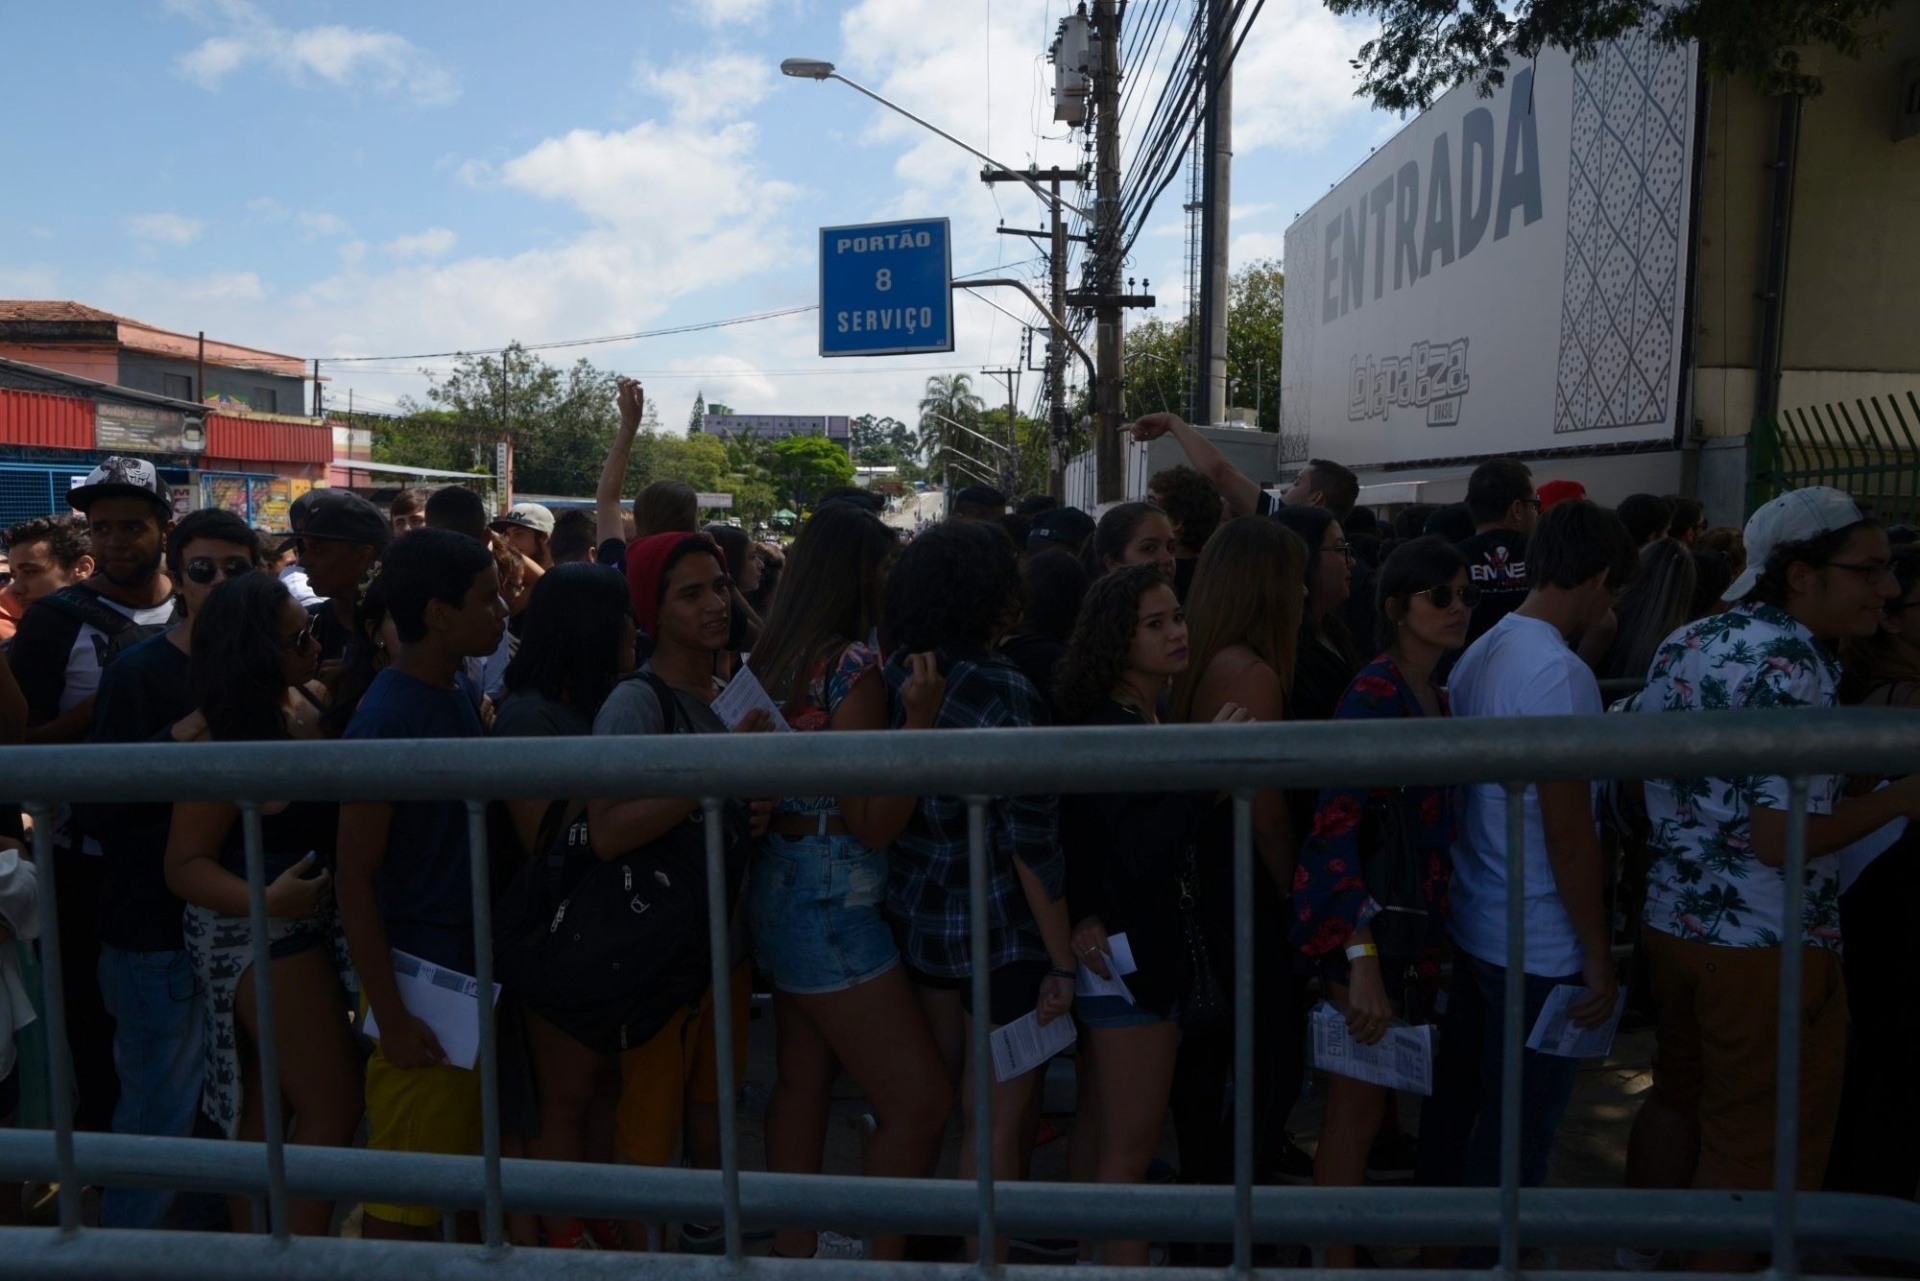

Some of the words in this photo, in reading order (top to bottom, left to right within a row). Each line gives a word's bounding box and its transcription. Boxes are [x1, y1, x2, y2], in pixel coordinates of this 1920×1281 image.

[1322, 66, 1543, 325] ENTRADA
[837, 229, 931, 254] PORTÃO
[875, 268, 892, 291] 8
[837, 307, 932, 335] SERVIÇO
[1434, 401, 1453, 421] BRASIL
